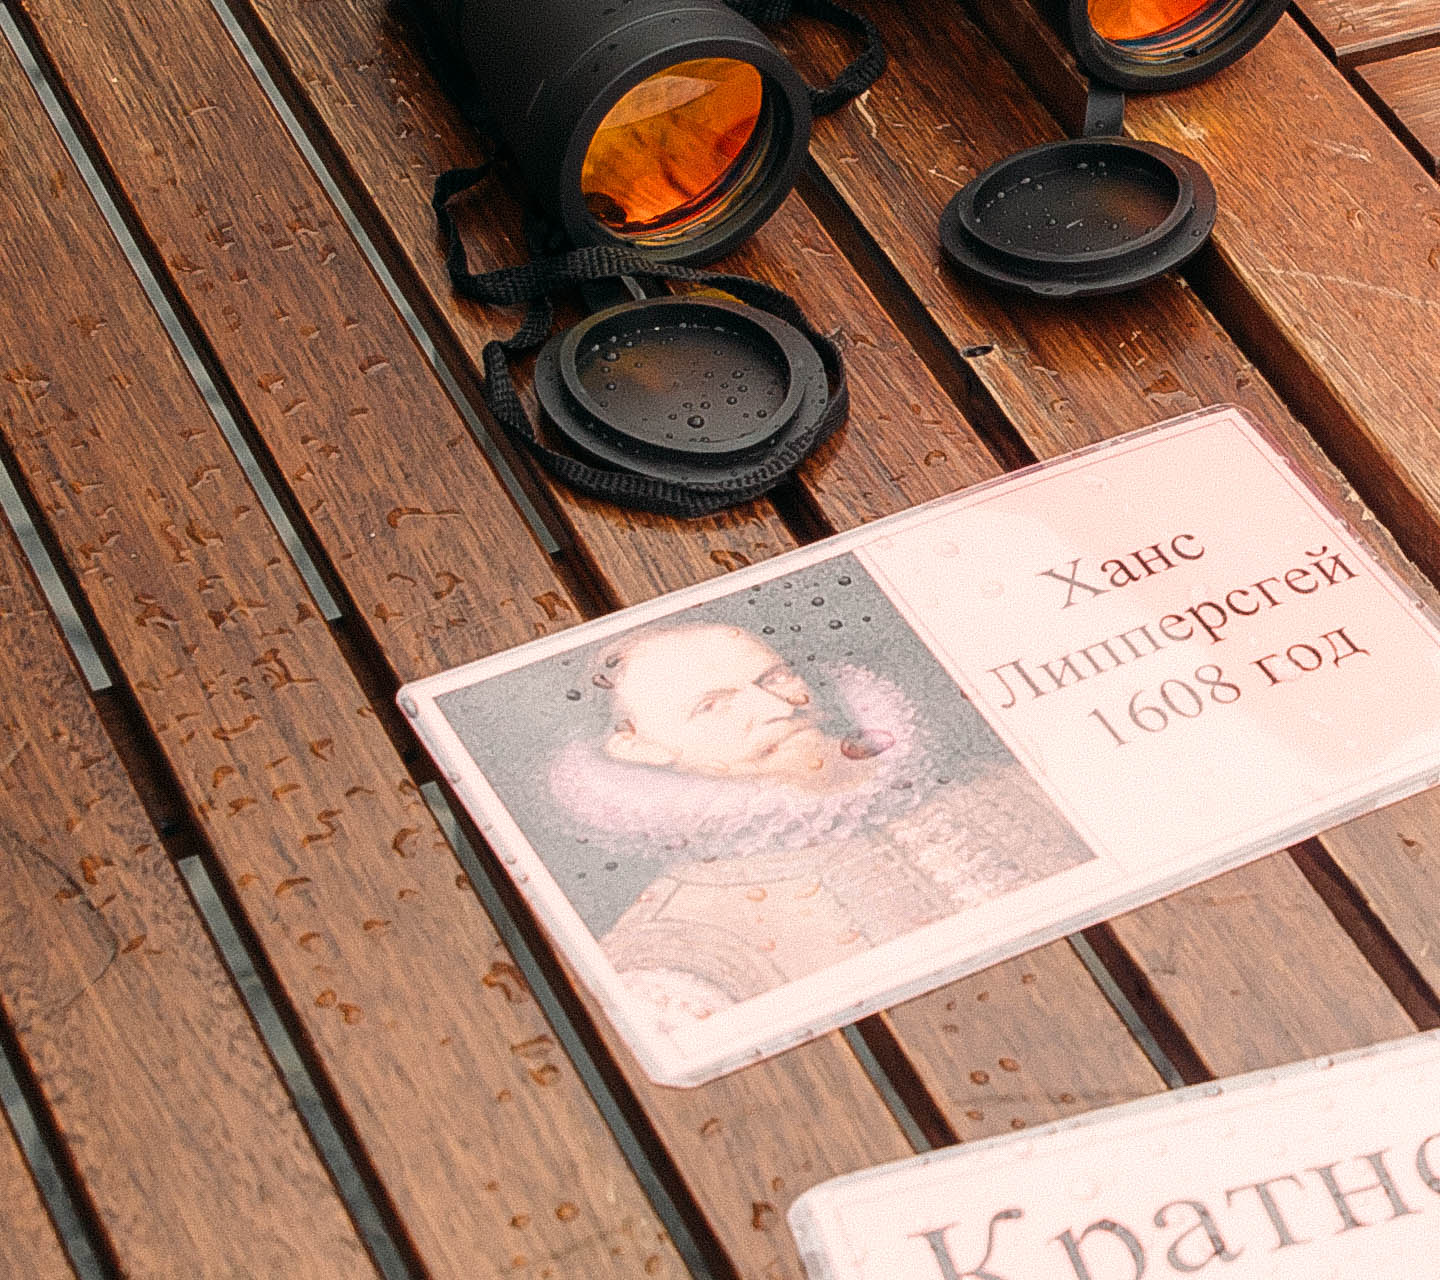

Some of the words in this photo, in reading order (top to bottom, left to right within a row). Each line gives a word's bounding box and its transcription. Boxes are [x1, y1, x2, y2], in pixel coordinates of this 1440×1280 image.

[985, 545, 1361, 710] Липперсгей
[1035, 533, 1206, 610] Ханс
[1087, 663, 1242, 747] 1608
[1249, 627, 1371, 687] год
